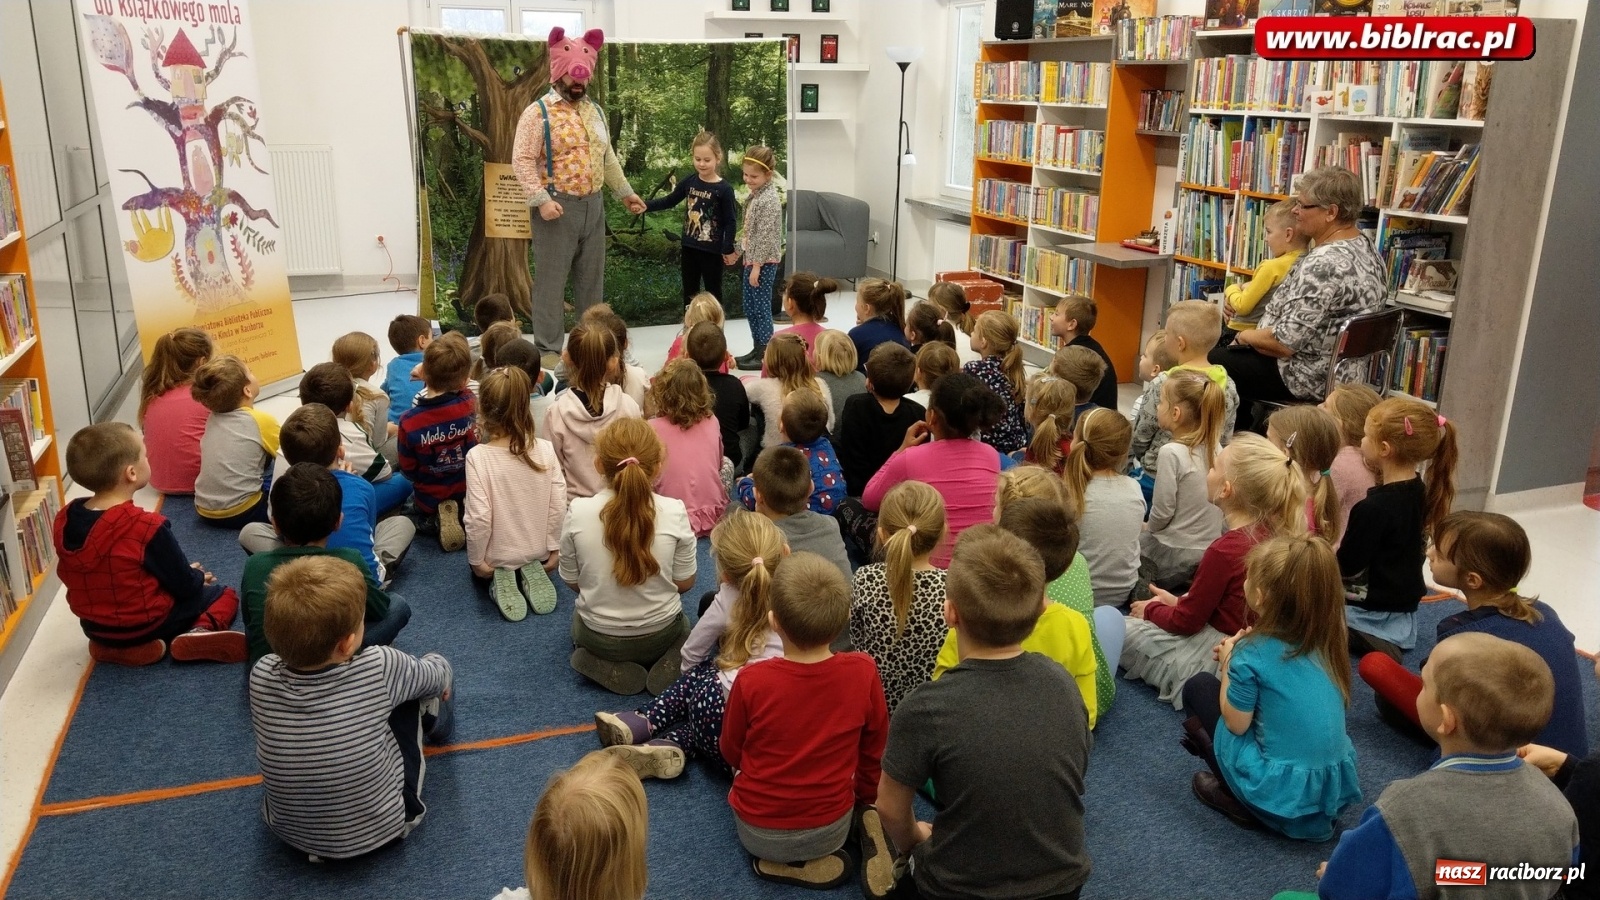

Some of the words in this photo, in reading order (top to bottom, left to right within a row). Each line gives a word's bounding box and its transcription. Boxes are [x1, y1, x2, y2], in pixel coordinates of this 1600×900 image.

[94, 0, 114, 16] do
[208, 0, 241, 25] mola
[224, 313, 250, 326] Biblioteka
[250, 308, 273, 320] Publiczna
[420, 426, 445, 447] Mods
